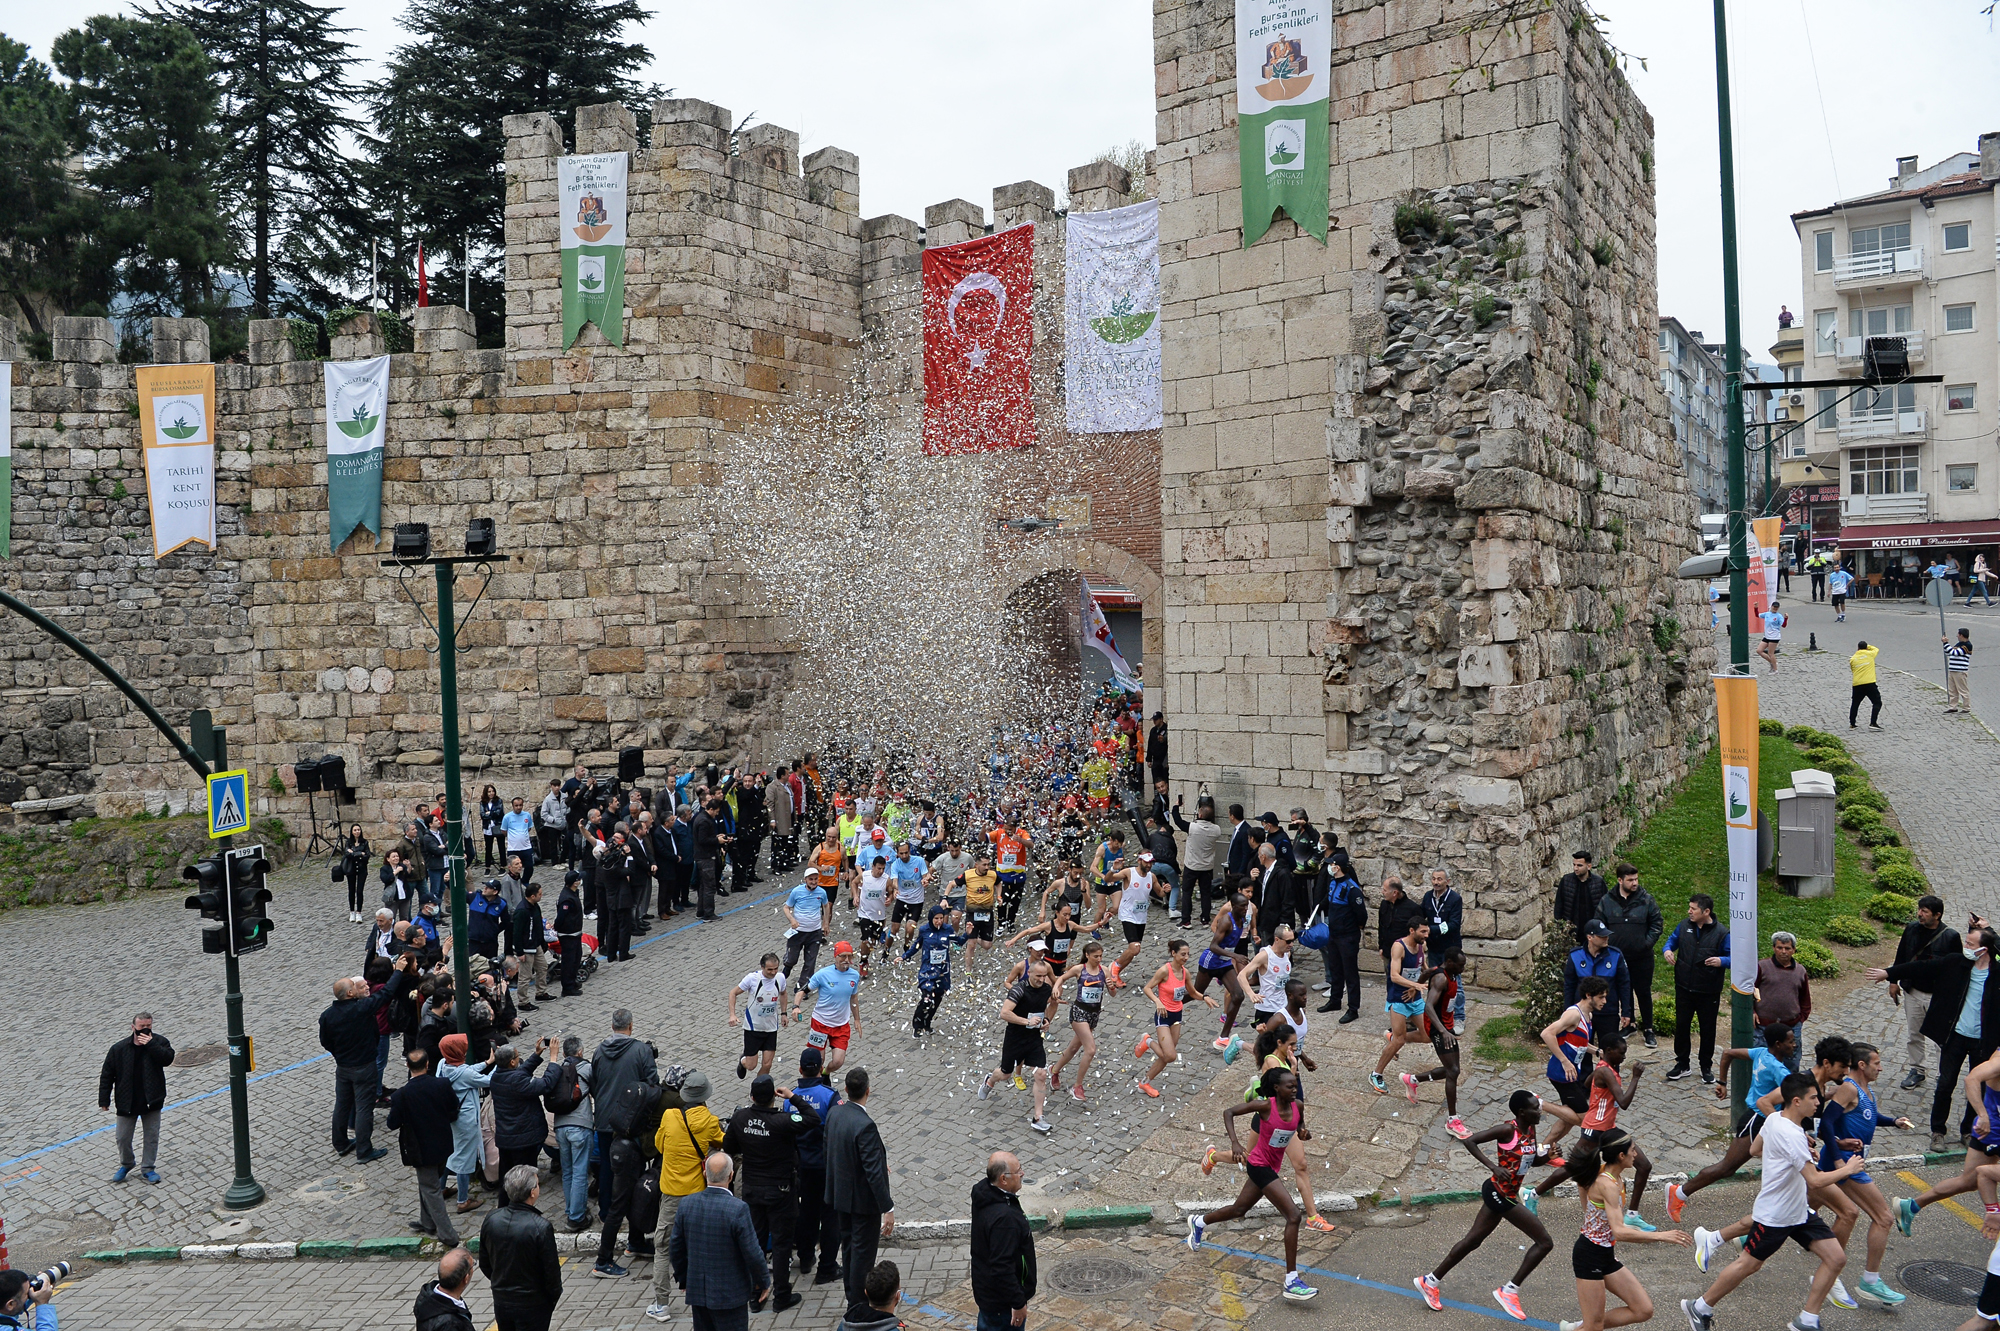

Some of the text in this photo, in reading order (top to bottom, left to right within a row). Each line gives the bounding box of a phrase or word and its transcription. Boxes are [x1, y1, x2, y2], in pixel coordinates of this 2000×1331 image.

[1249, 24, 1270, 39] Fethi
[568, 157, 591, 166] Osman
[166, 465, 204, 476] TARİHİ
[173, 483, 202, 493] KENT
[1810, 494, 1820, 502] ET
[167, 498, 210, 510] KOŞUSU
[1871, 538, 1921, 548] KIVILCIM
[239, 848, 251, 856] 199
[761, 1006, 775, 1014] 756
[748, 1118, 766, 1129] ÖZEL
[743, 1127, 771, 1137] GÜVENLİK
[1278, 1136, 1290, 1144] 59
